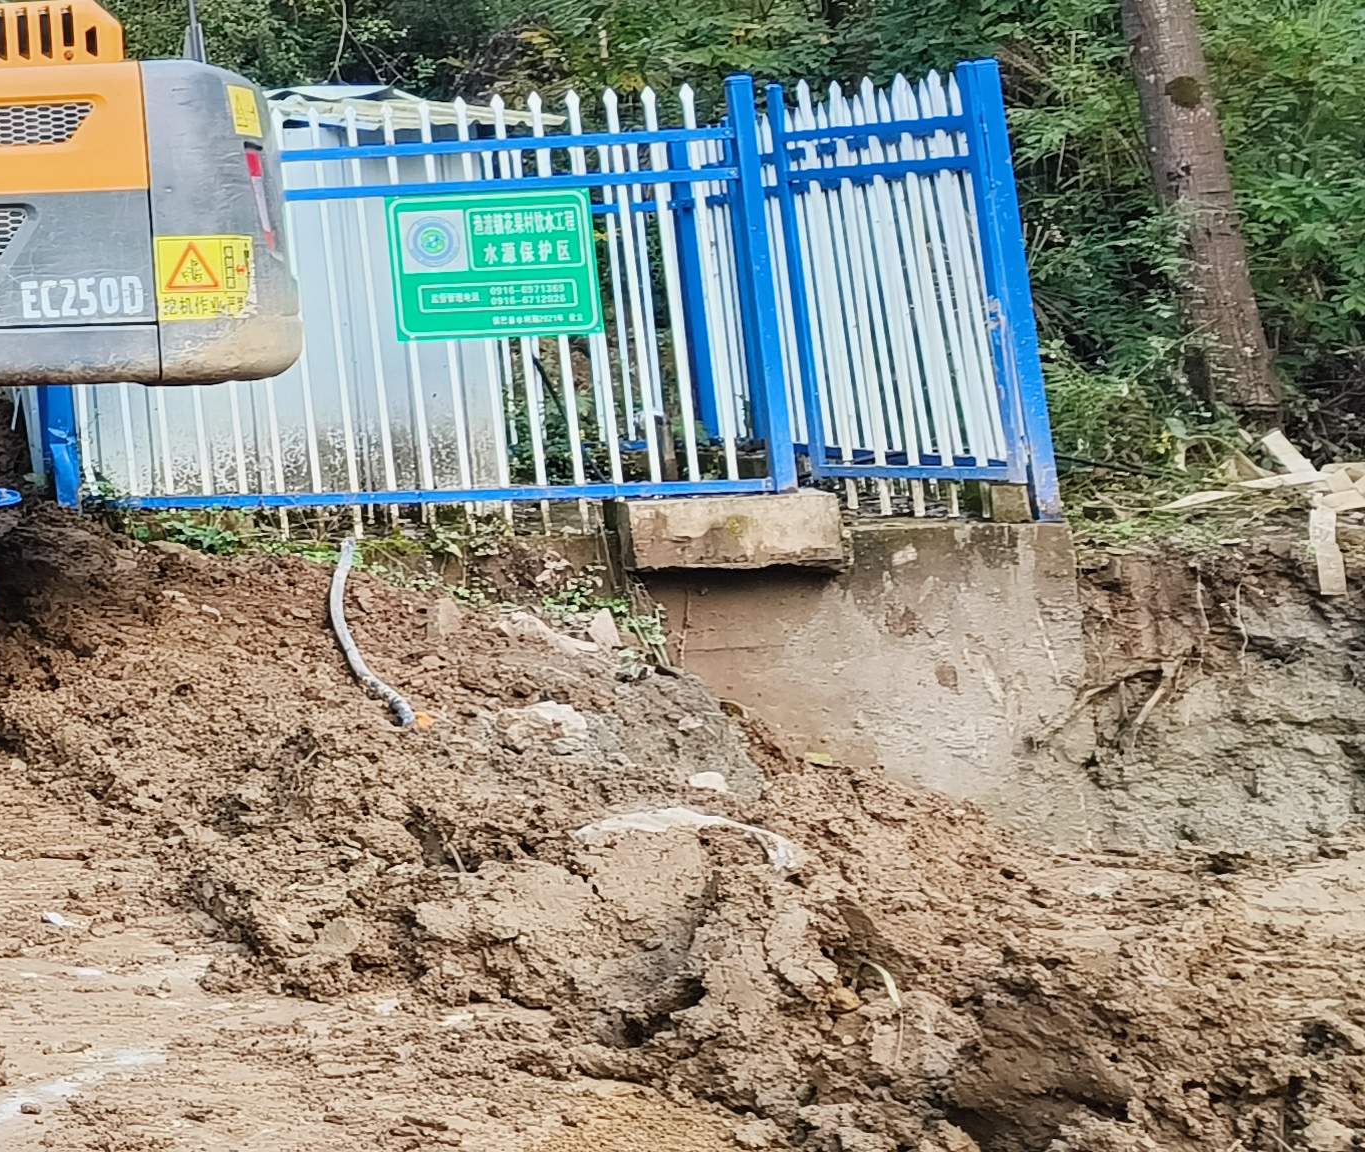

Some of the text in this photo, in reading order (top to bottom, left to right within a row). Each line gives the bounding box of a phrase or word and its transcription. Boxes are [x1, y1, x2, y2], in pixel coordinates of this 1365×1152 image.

[483, 240, 571, 265] 水源保护区
[20, 275, 144, 319] EC250D
